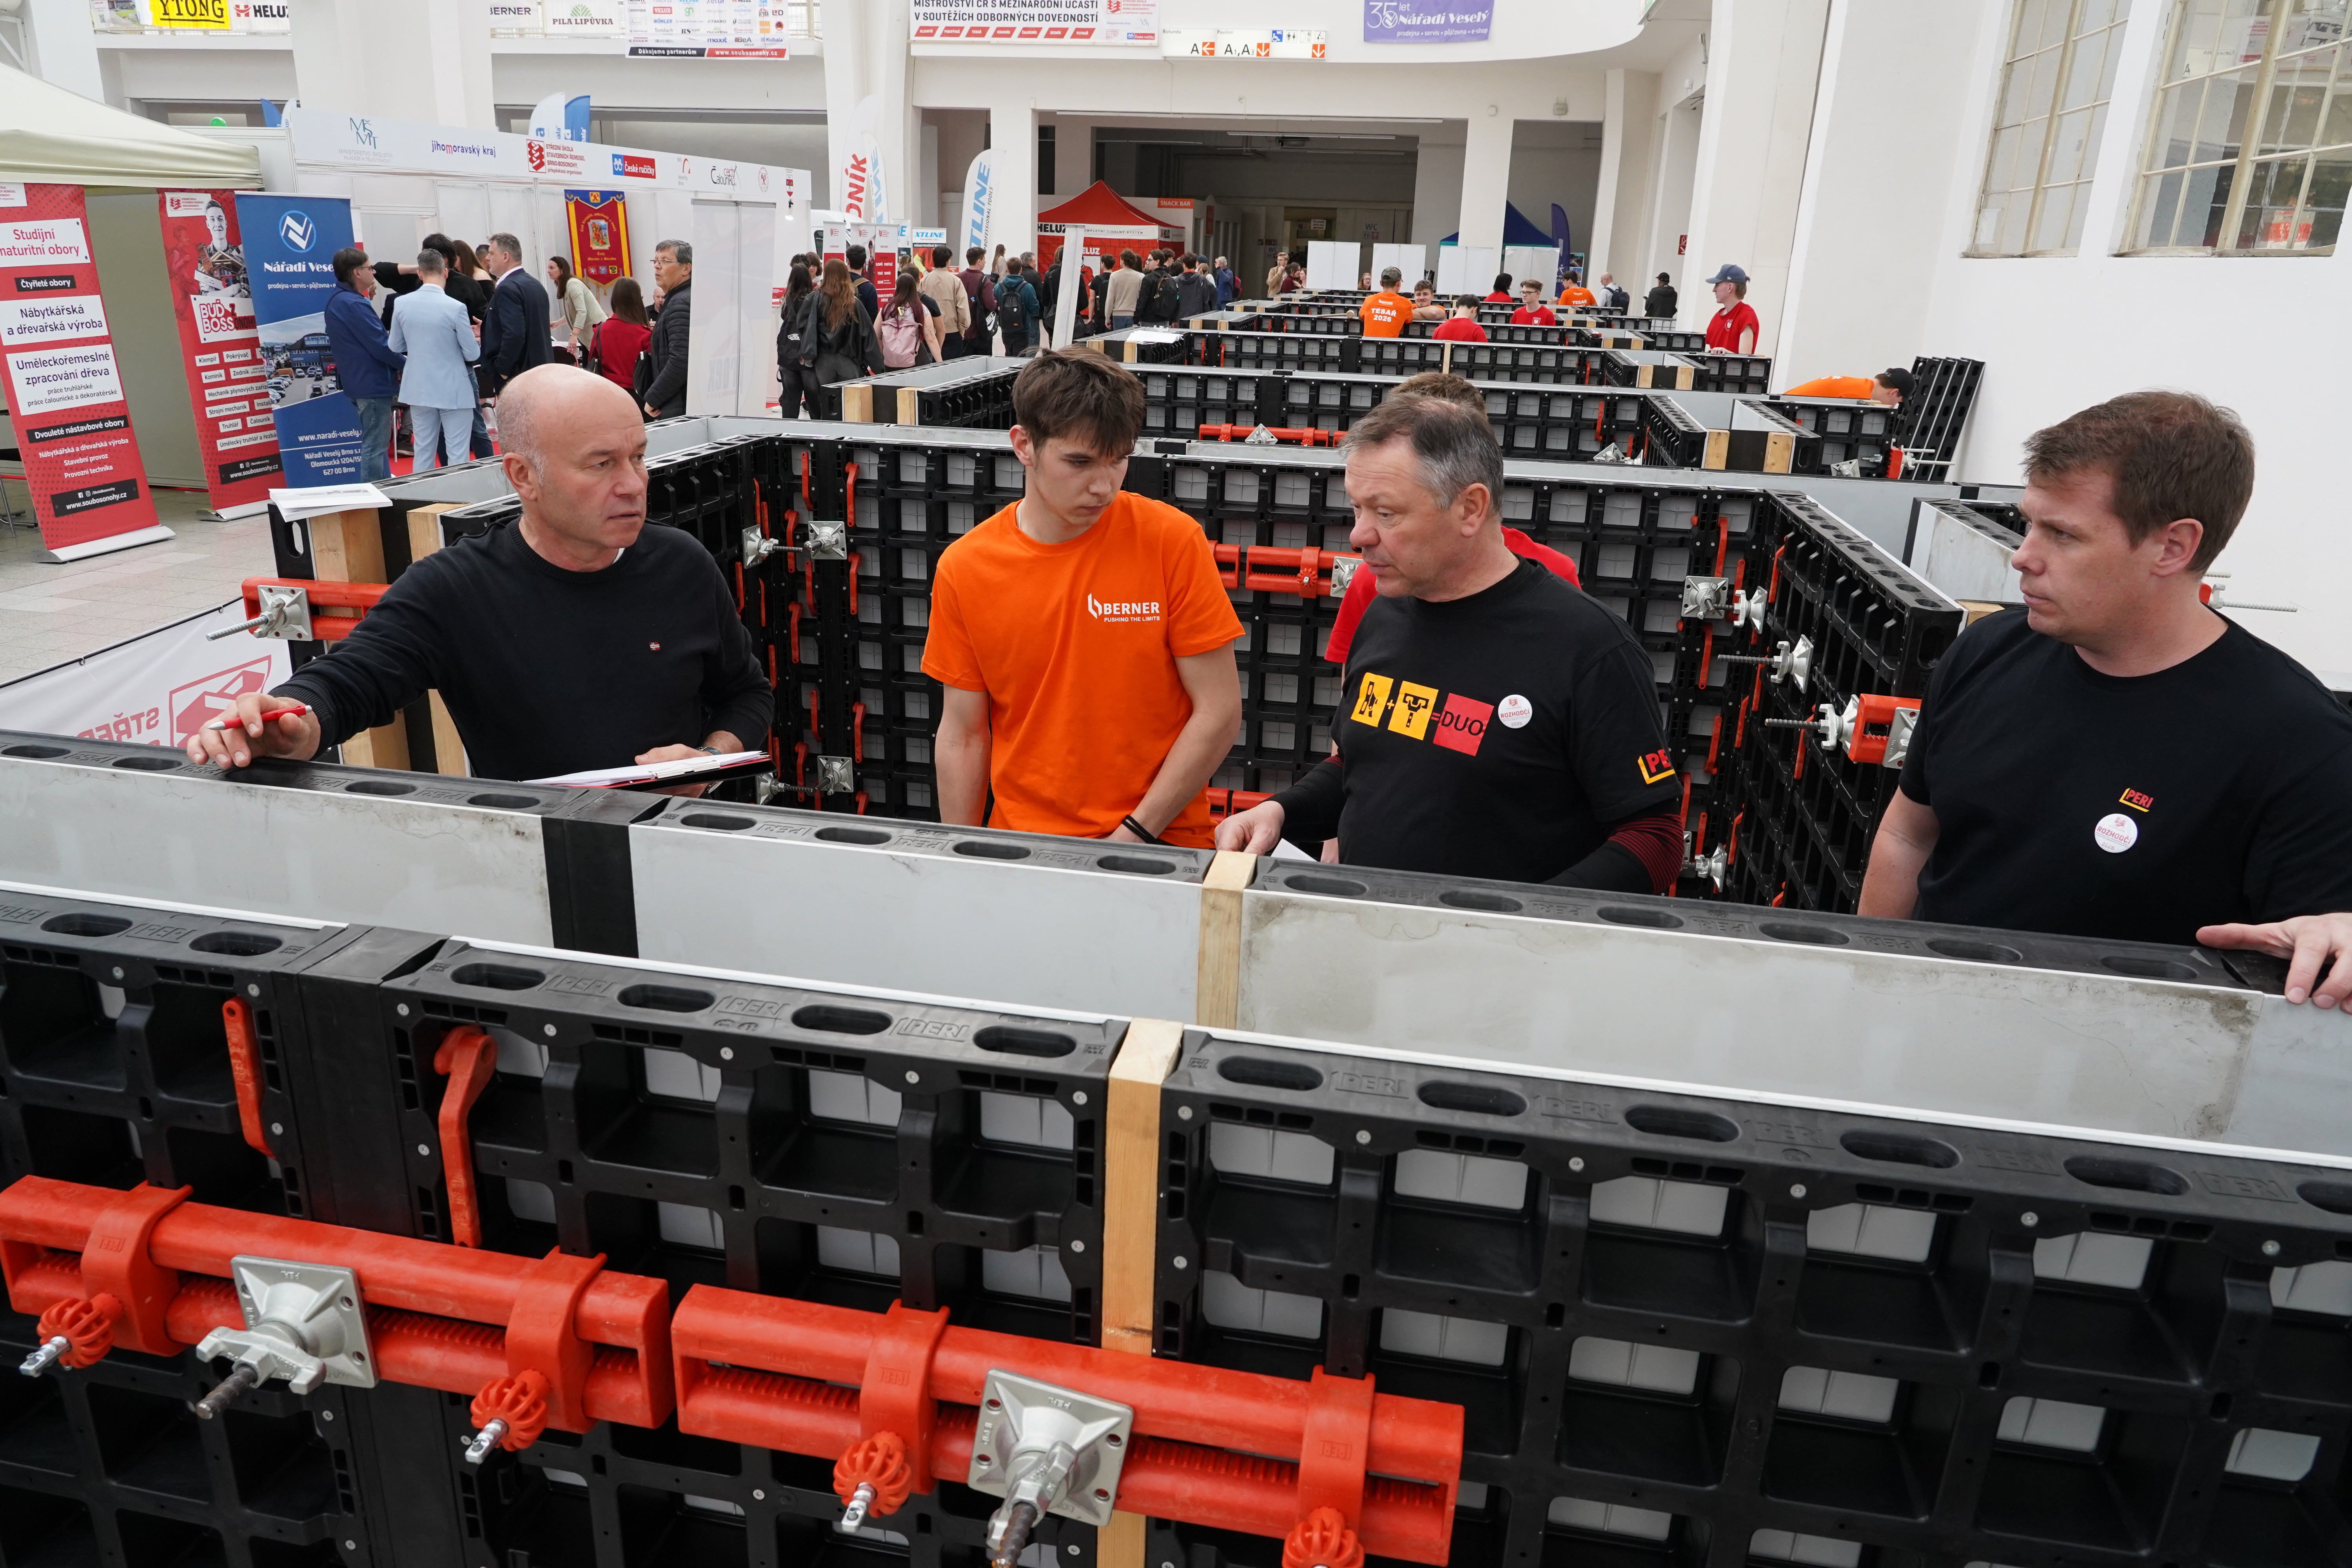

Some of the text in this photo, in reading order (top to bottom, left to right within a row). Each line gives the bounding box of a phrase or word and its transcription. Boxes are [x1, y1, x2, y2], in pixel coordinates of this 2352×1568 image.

[160, 0, 224, 18] YTONG
[1399, 2, 1410, 11] let
[575, 16, 613, 25] LIPŮVKA
[923, 11, 974, 21] SOUTĚŽÍCH
[976, 11, 1035, 22] ODBORNÝCH
[1038, 12, 1098, 22] DOVEDNOSTÍ
[1398, 11, 1490, 25] Nářadí Veselý
[1397, 30, 1420, 38] prodejna
[1444, 28, 1467, 36] půjčovna
[1471, 27, 1488, 36] e-shop
[1190, 44, 1199, 54] A
[432, 140, 496, 157] jihomoravský kraj
[625, 161, 655, 176] České ručičky
[970, 162, 991, 247] TLINE
[13, 229, 55, 242] Studijní
[984, 210, 992, 252] PROFESSIONAL
[49, 244, 79, 256] obory
[264, 261, 334, 272] Nářadí Vese
[21, 279, 48, 289] Čtyřleté
[20, 304, 85, 319] Nábytkářská
[200, 299, 225, 319] BUĎ
[1371, 308, 1397, 317] TESAŘ
[17, 321, 65, 334] dřevařská
[67, 319, 103, 332] výroba
[201, 316, 257, 333] BOSSONOH
[16, 351, 110, 370] Uměleckořemeslné
[25, 367, 109, 387] zpracování dřeva
[64, 383, 93, 392] truhlářské
[230, 386, 254, 395] plynových
[45, 394, 74, 404] čalounické
[80, 388, 118, 399] dekoratérské
[34, 419, 125, 439] Dvouleté nástavbové obory
[298, 429, 362, 442] www.naradi-vesely.
[39, 446, 75, 458] Nábytkářská
[80, 441, 108, 451] dřevařská
[108, 438, 129, 446] výroba
[220, 439, 242, 448] Umělecký
[243, 435, 258, 443] truhlář
[64, 454, 109, 466] Stavební provoz
[304, 452, 322, 460] Nářadí
[323, 450, 341, 458] Veselý
[310, 459, 340, 468] Olomoucká
[64, 465, 113, 479] Provozní technika
[230, 464, 279, 479] www.soubosonohy.cz
[66, 492, 127, 510] www.soubosonohy.cz
[1103, 602, 1160, 615] BERNER
[1501, 709, 1530, 718] ROZHODČÍ
[1441, 711, 1484, 736] DUO
[421, 791, 463, 800] PERI
[2125, 789, 2154, 808] PERI
[757, 824, 804, 834] PERI
[2097, 826, 2133, 844] ROZHODČÍ
[896, 838, 942, 850] PERI
[2102, 842, 2115, 850] 2026
[1036, 853, 1085, 864] PERI
[134, 924, 196, 940] PERI
[561, 976, 616, 993] PERI
[730, 998, 790, 1018] PERI
[907, 1019, 971, 1039] PERI
[1343, 1074, 1405, 1093] PERI
